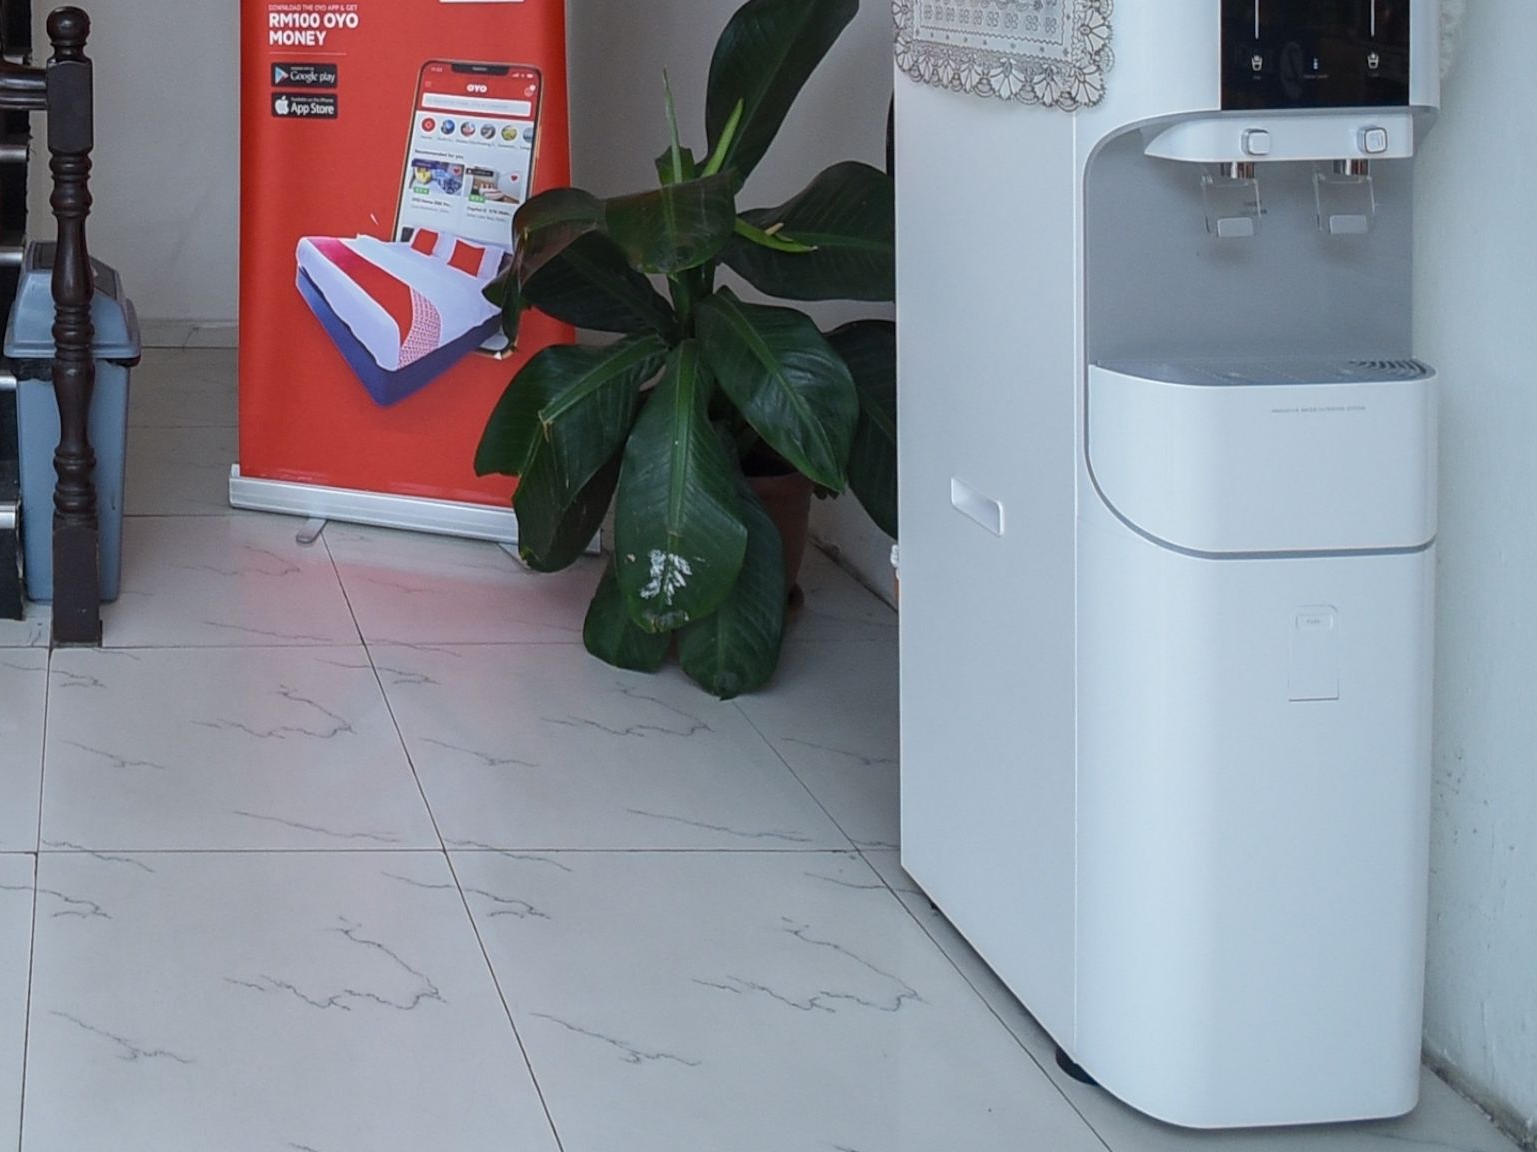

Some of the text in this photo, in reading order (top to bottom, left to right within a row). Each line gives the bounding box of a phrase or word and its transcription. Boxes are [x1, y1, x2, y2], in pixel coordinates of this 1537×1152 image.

[268, 4, 302, 12] DOWNLOAD
[302, 4, 314, 12] THE
[314, 4, 327, 12] OYO
[327, 4, 340, 12] APP
[269, 12, 359, 29] RM100 OYO
[269, 30, 327, 46] MONEY
[290, 70, 336, 84] Google play
[466, 84, 488, 93] OYO
[291, 102, 335, 116] App Store
